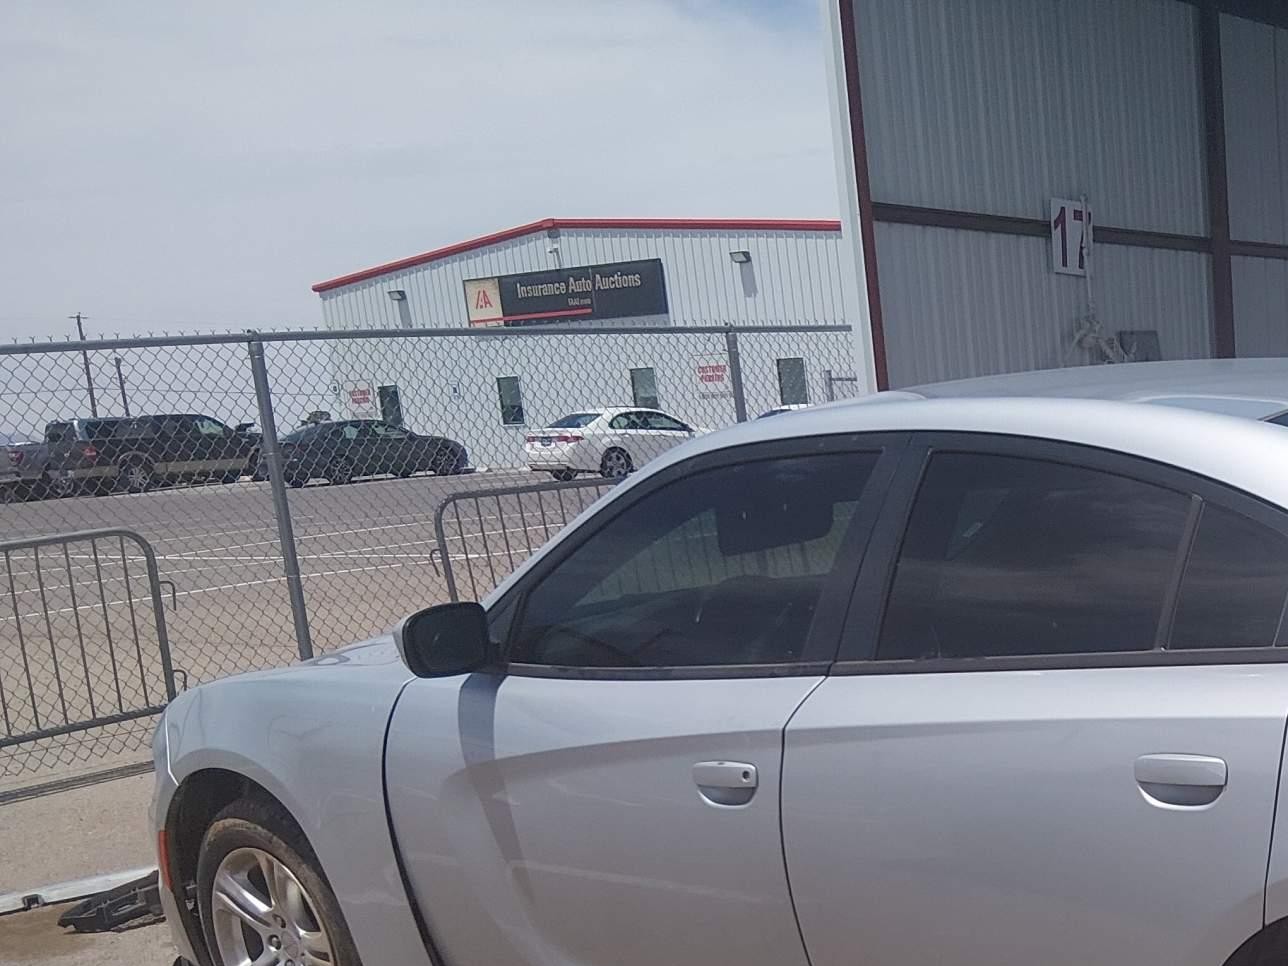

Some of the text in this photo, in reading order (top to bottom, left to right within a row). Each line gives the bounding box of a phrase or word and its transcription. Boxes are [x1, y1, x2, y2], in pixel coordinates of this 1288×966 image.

[1054, 206, 1092, 270] 17
[517, 271, 641, 299] Insurance Auto Auctions
